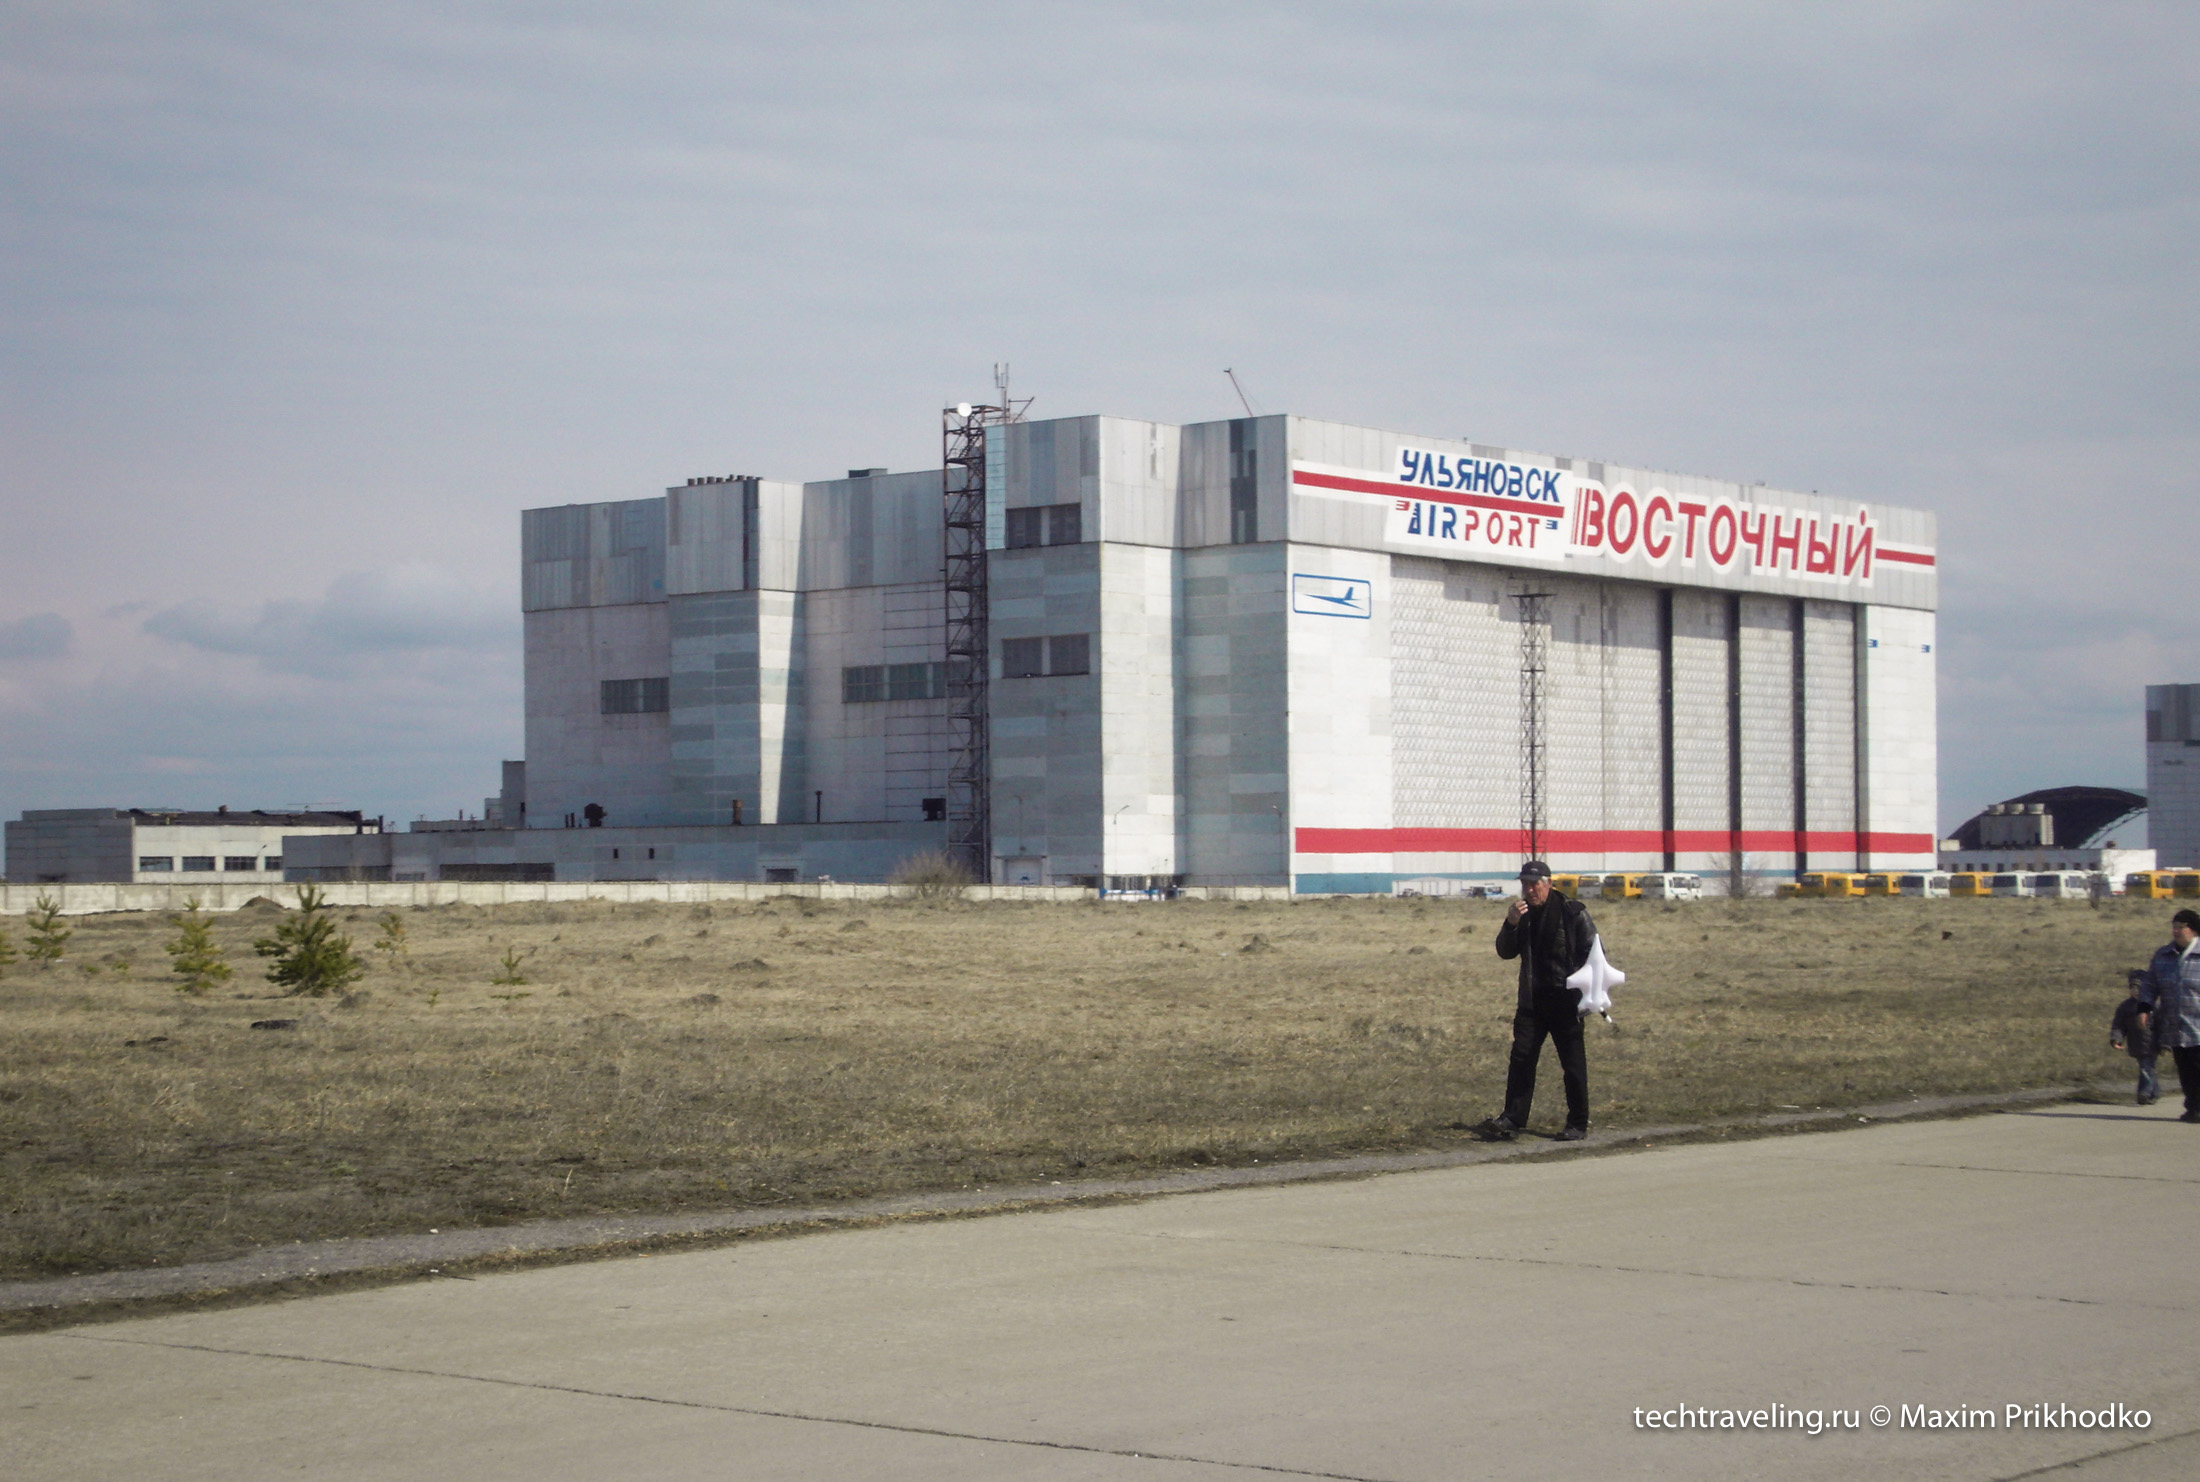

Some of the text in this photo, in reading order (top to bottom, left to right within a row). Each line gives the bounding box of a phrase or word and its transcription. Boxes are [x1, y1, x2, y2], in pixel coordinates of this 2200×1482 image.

[1400, 449, 1561, 503] УЛЬЯНОВСК
[1407, 502, 1540, 549] AIRPORT
[1570, 486, 1874, 579] ВОСТОЧНЫЙ
